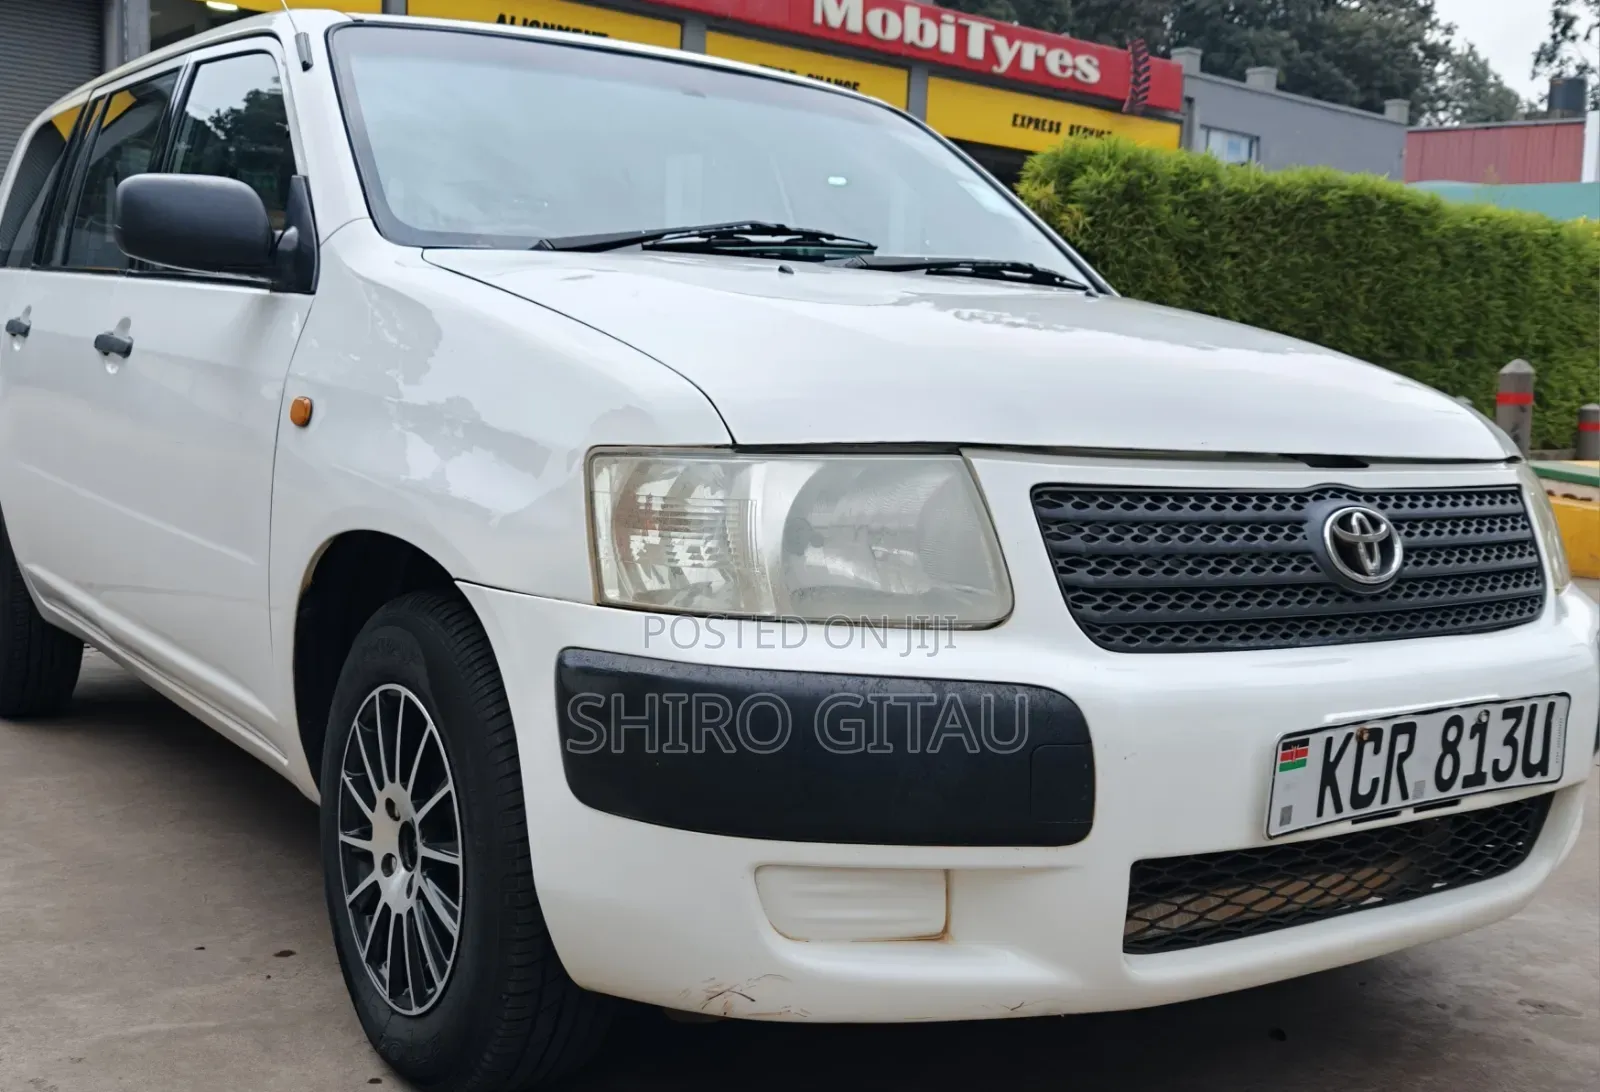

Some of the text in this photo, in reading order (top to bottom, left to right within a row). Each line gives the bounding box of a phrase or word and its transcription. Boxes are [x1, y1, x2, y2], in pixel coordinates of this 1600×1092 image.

[812, 0, 1100, 84] MobiTyres
[1011, 112, 1062, 135] EXPRESS
[1316, 721, 1417, 818] KCR
[1434, 701, 1555, 793] 813U
